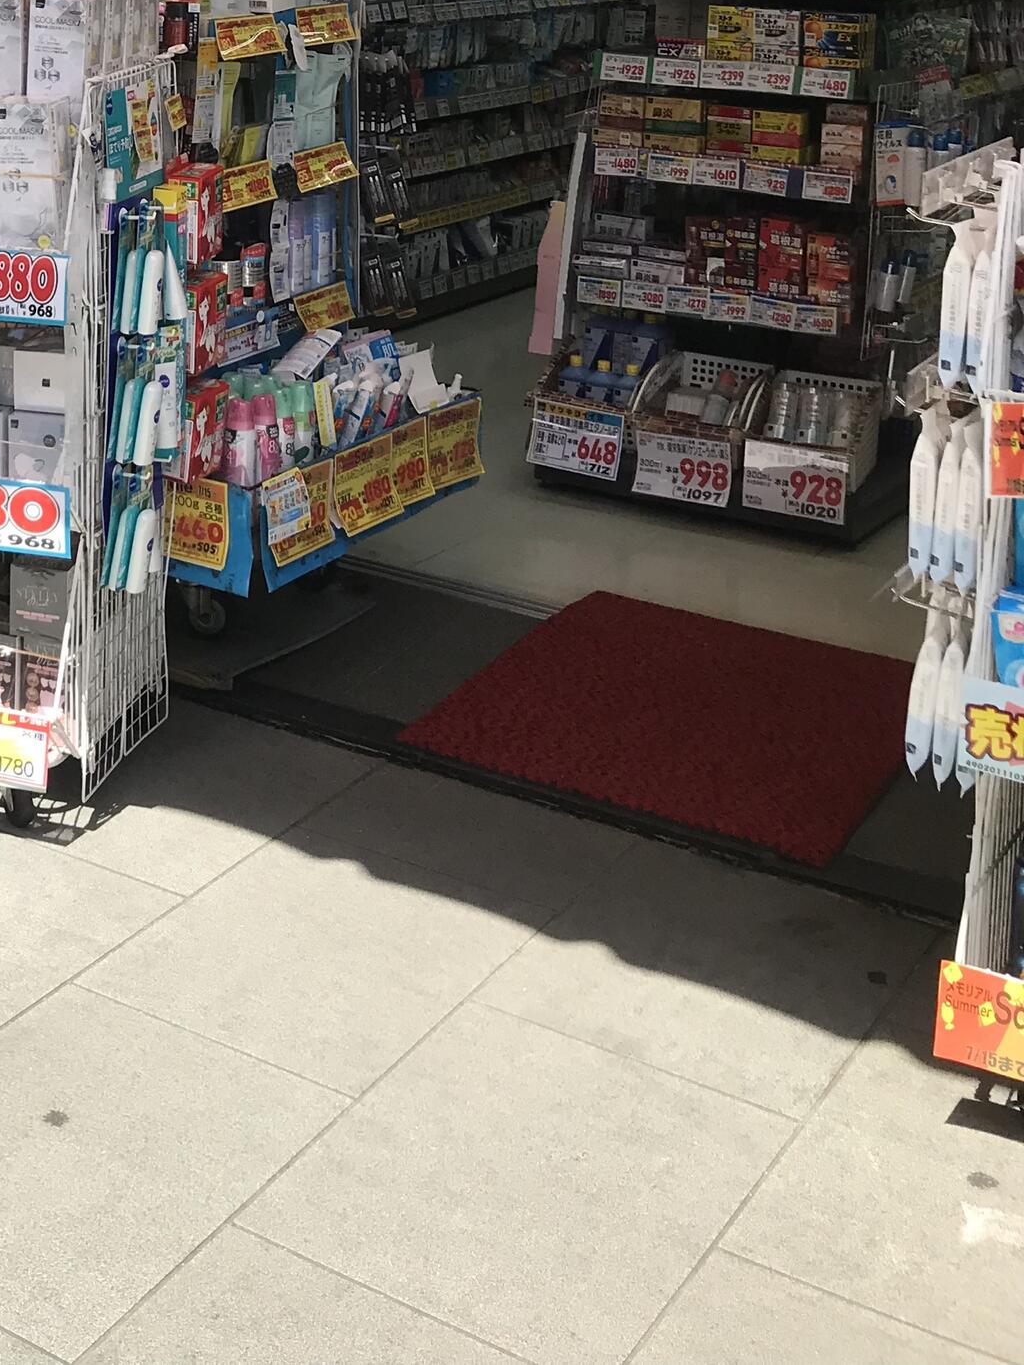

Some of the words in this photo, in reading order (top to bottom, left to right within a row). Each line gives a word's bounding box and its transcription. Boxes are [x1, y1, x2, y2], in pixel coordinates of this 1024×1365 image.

[28, 305, 54, 318] 968
[576, 436, 617, 466] 648
[679, 457, 729, 492] 998
[687, 490, 722, 504] 1097
[789, 470, 843, 507] 928
[800, 505, 837, 519] 1020
[7, 533, 56, 550] 968
[945, 981, 993, 1002] メモリアル
[944, 995, 992, 1019] Summer
